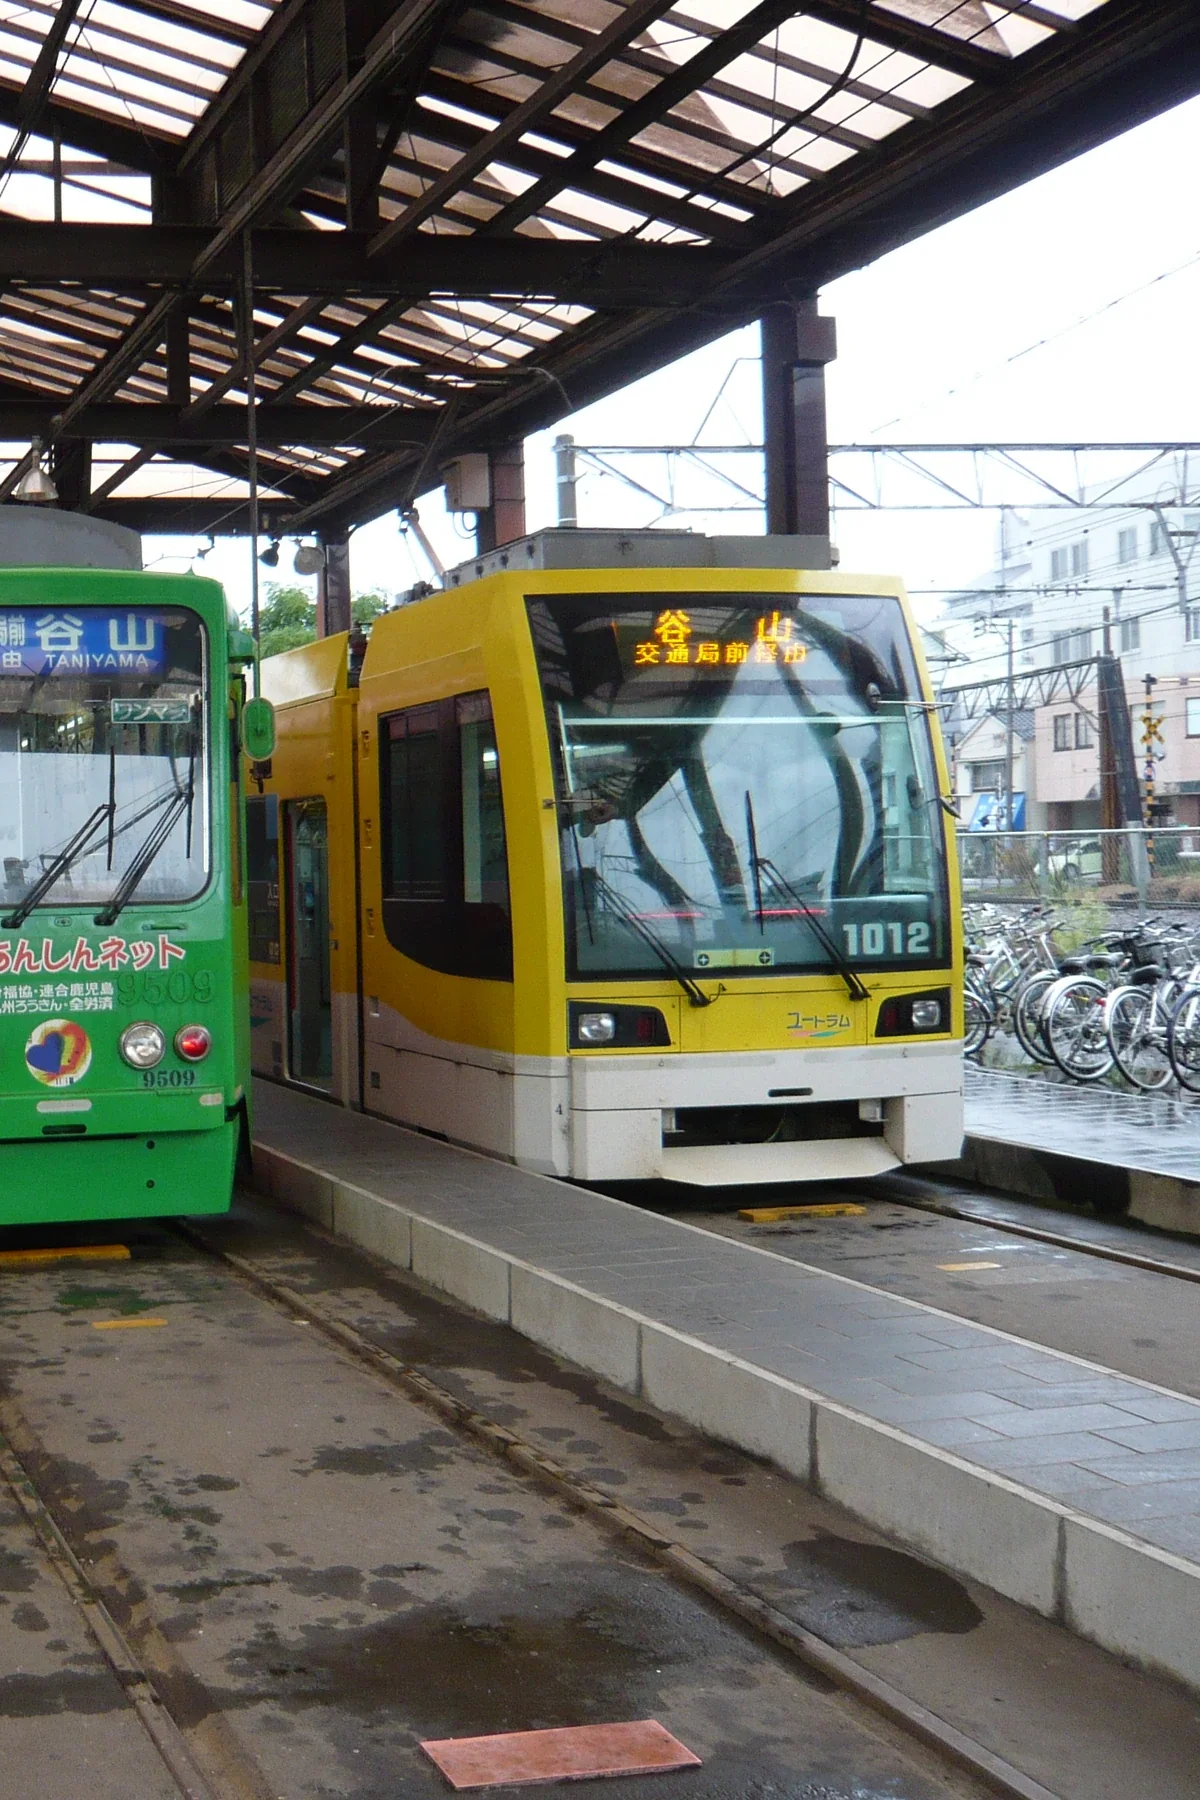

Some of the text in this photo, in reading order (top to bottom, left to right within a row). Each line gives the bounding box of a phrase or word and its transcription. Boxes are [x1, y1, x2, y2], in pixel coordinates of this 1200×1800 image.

[35, 614, 154, 651] 谷山
[46, 654, 149, 668] TANIYAMA
[635, 642, 807, 664] 交通局前経由
[115, 702, 187, 720] ワンマン
[843, 922, 930, 955] 1012
[786, 1011, 851, 1029] ユートラム
[142, 1070, 196, 1087] 9509
